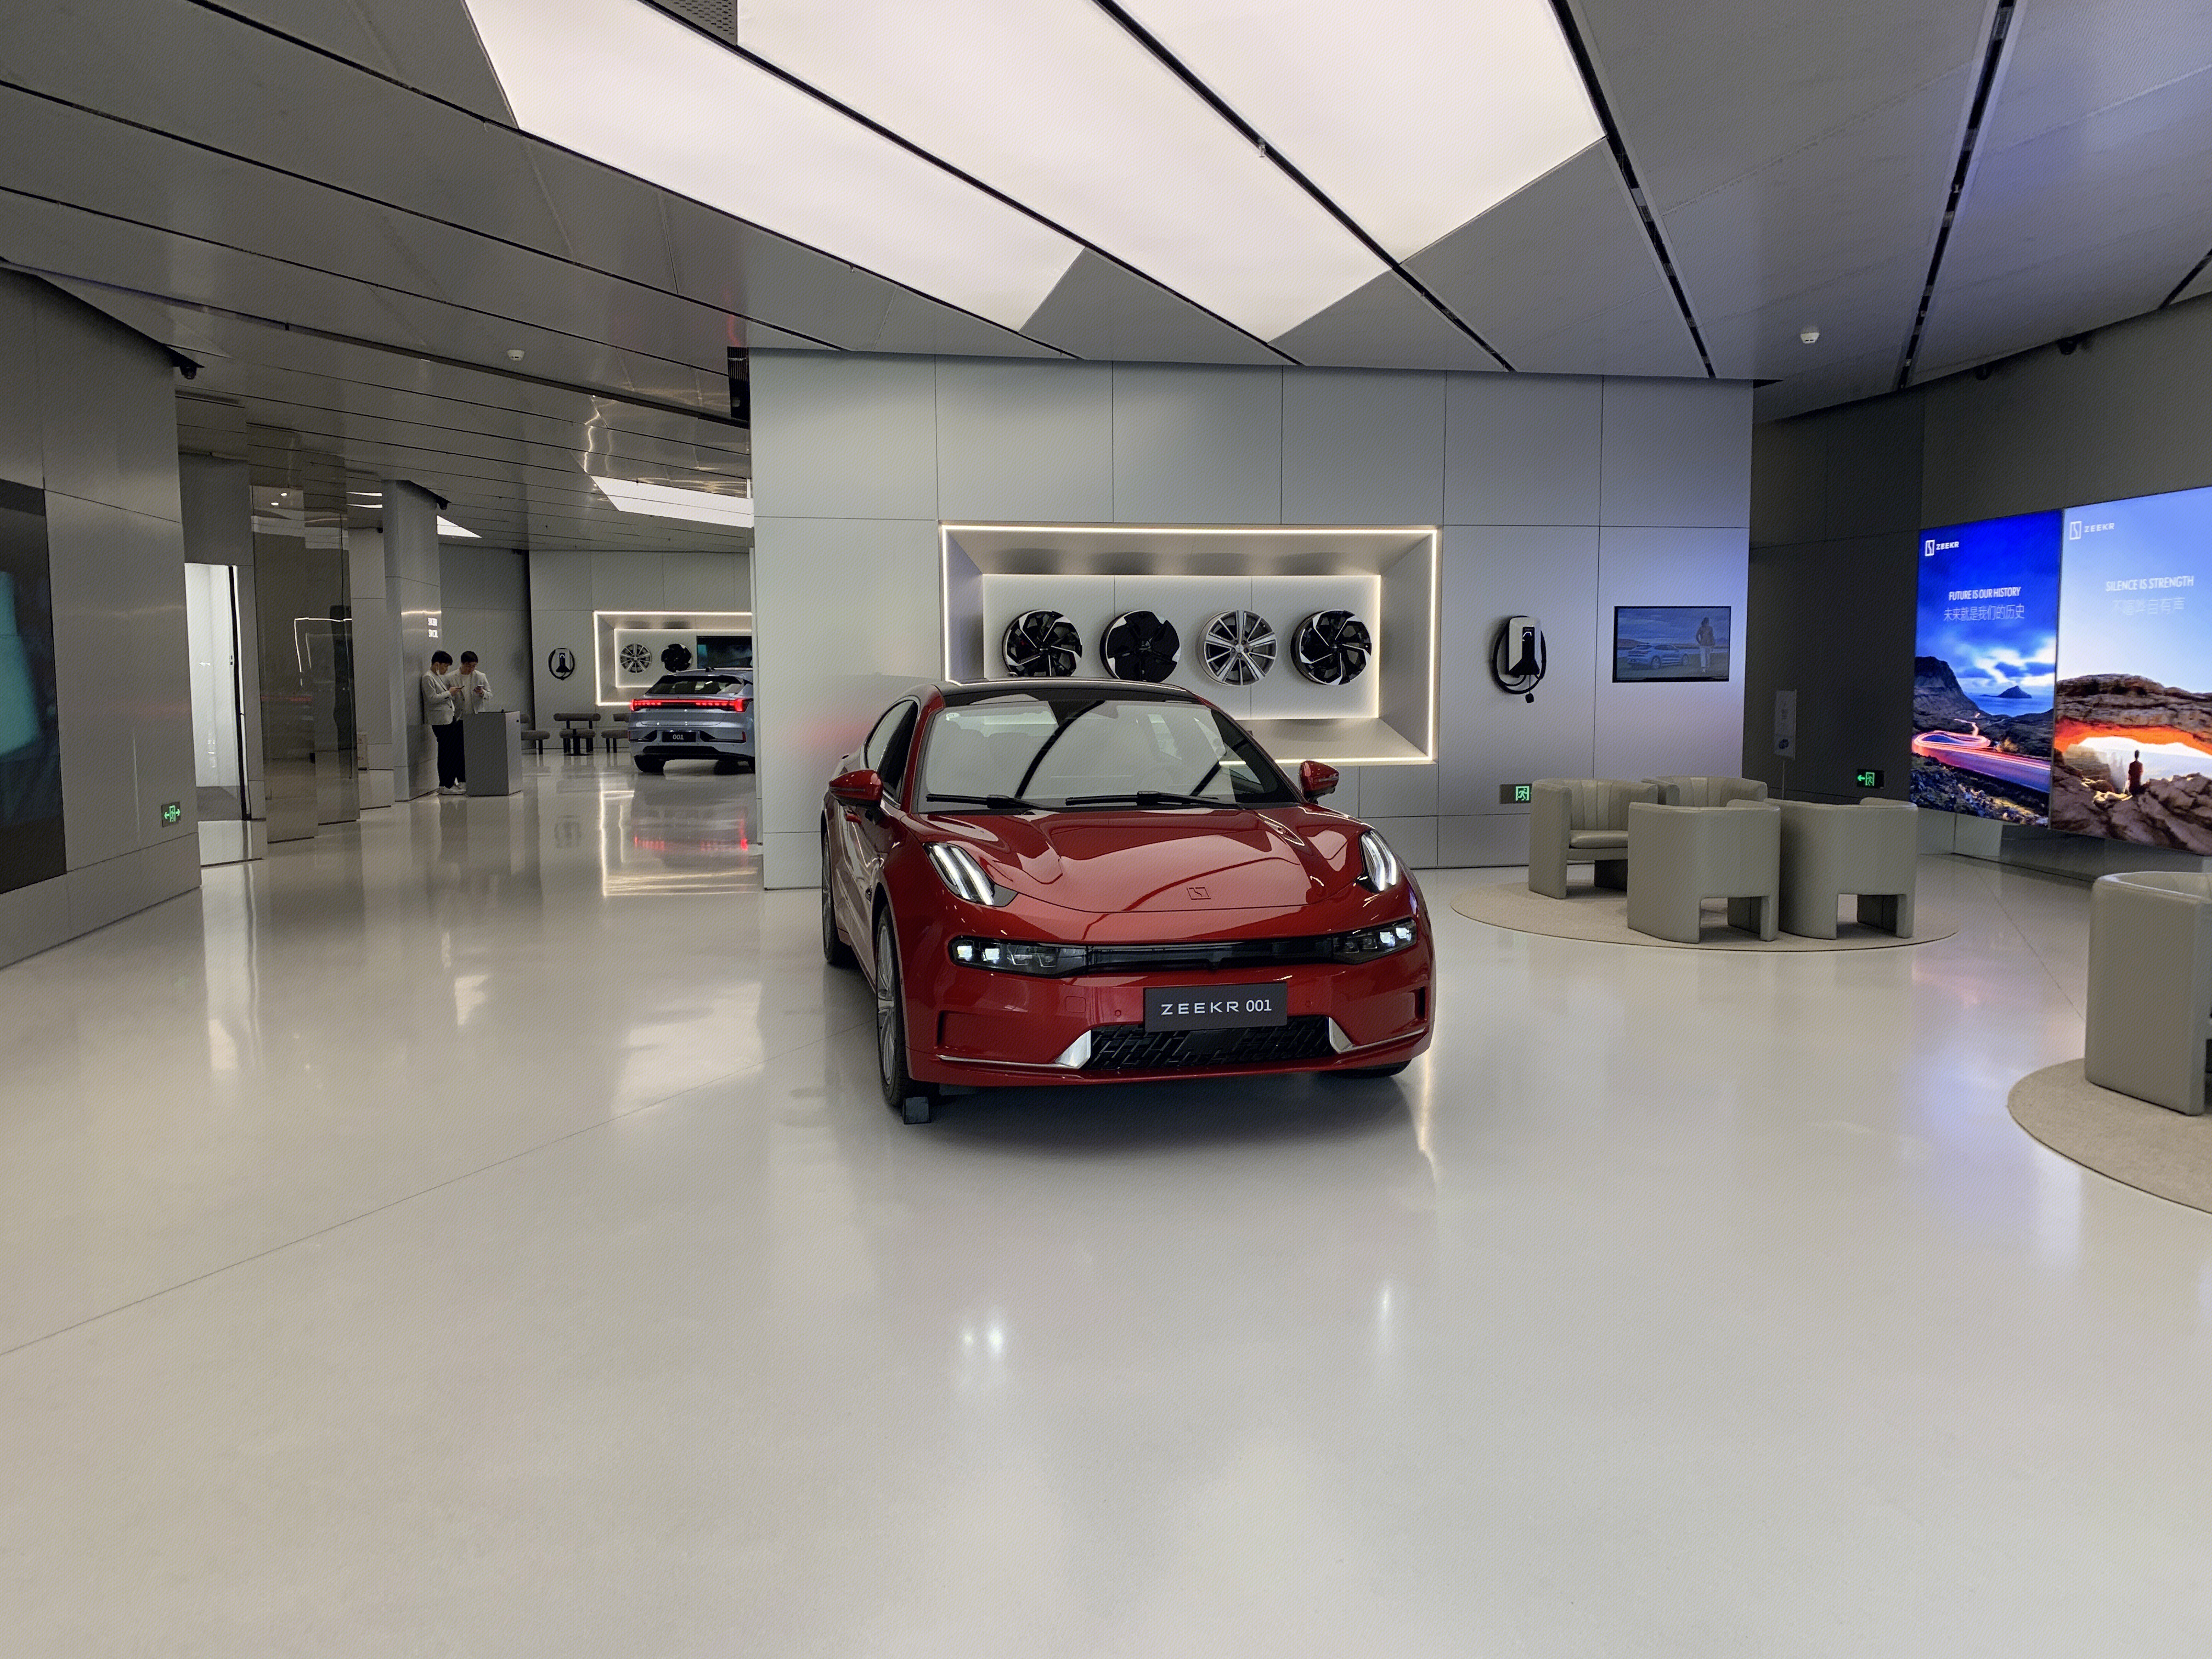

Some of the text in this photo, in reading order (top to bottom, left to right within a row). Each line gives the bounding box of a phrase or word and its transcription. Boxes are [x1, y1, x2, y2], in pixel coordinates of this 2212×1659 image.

[2084, 523, 2115, 533] ZEEKR
[1936, 541, 1959, 550] ZEEKR
[2106, 575, 2194, 592] SILENCE IS STRENGTH
[1949, 586, 2022, 601] FUTURE IS OUR HISTORY
[1943, 603, 2025, 622] 未来就是我们的历史
[1161, 1000, 1272, 1015] ZEEKR 001
